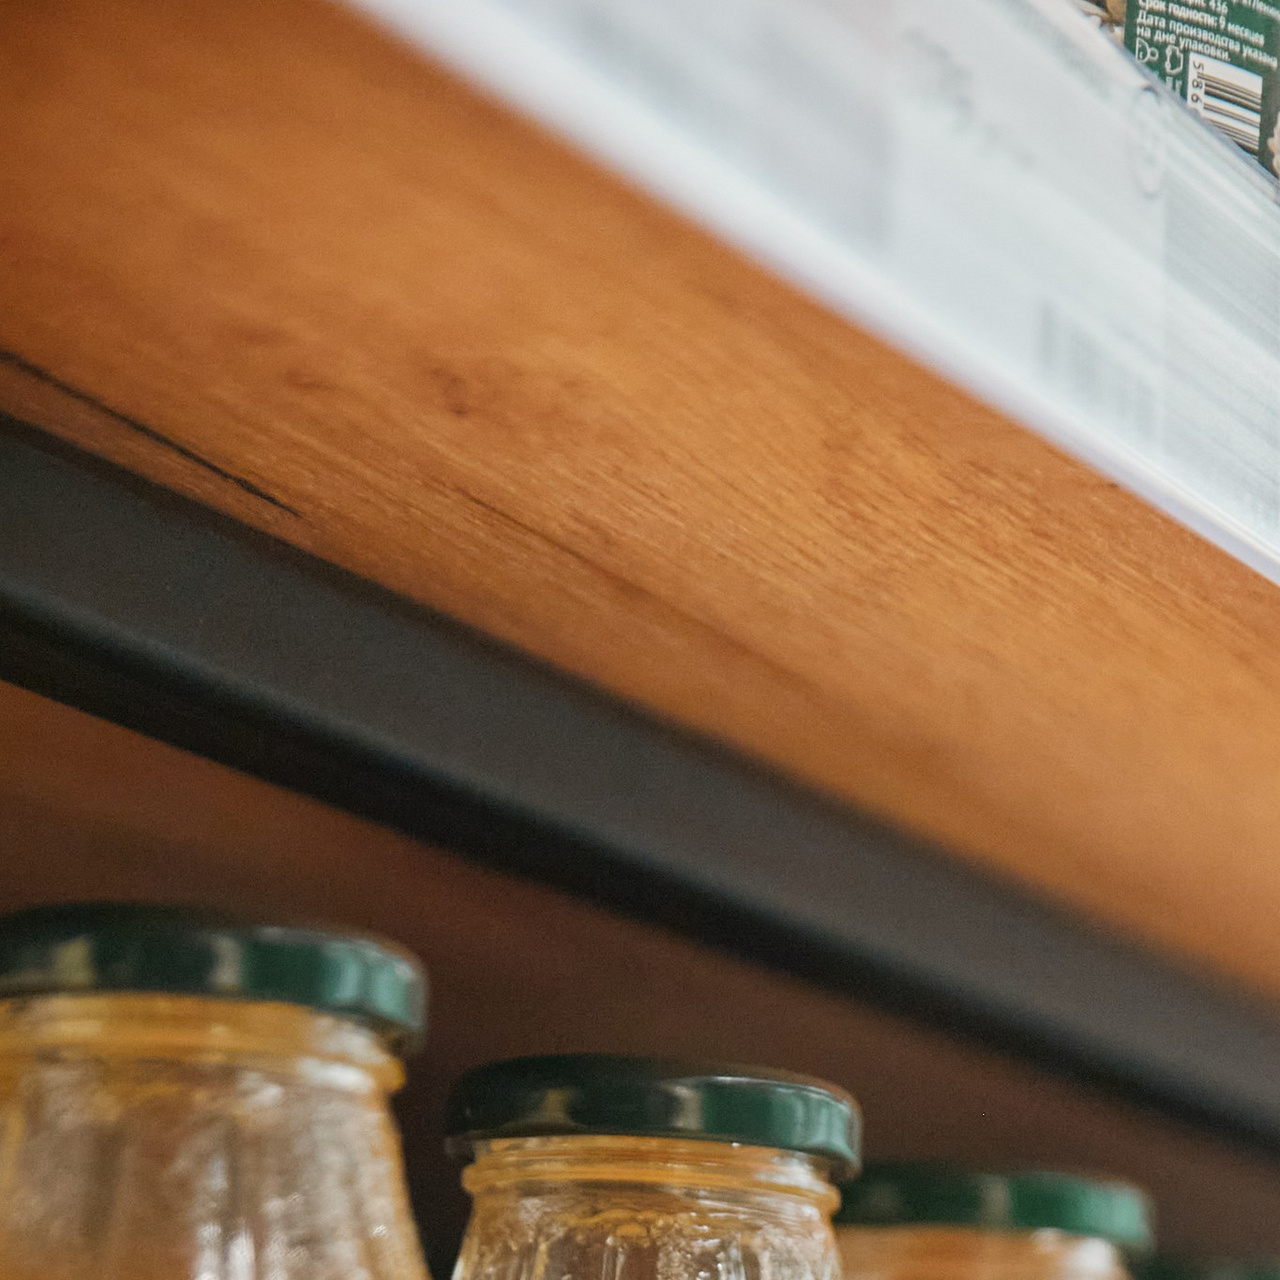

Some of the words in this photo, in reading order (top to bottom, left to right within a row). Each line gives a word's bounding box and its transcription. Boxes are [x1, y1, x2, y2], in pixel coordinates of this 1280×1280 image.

[1136, 9, 1166, 28] Дата
[1169, 20, 1240, 53] производства
[1136, 26, 1151, 38] на
[1153, 30, 1176, 44] дне
[1178, 35, 1231, 62] упаковки.
[1138, 0, 1166, 13] Срок
[1168, 2, 1218, 27] годности:
[1219, 15, 1226, 30] 9
[1227, 22, 1265, 47] месяцев
